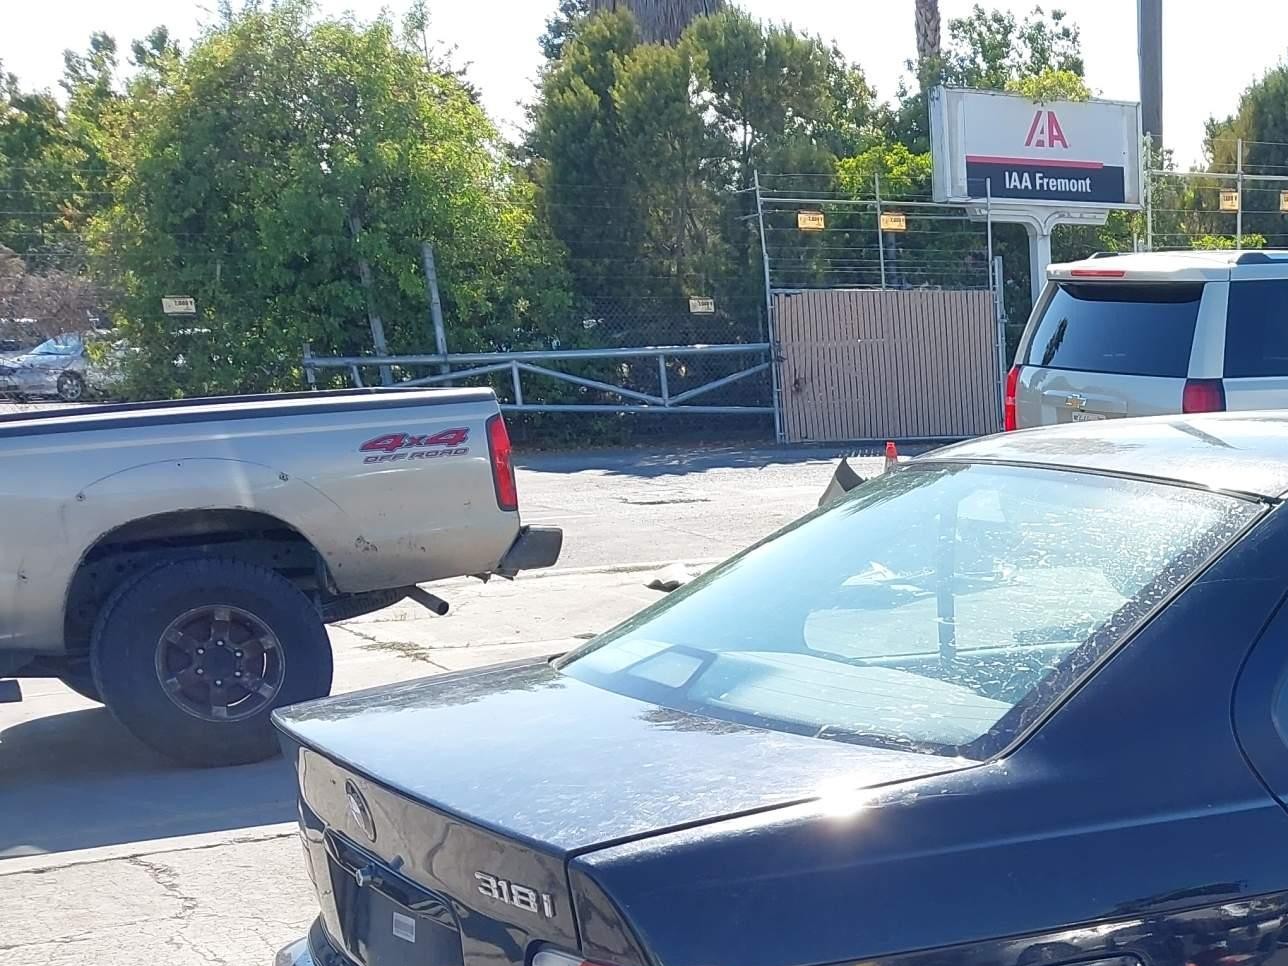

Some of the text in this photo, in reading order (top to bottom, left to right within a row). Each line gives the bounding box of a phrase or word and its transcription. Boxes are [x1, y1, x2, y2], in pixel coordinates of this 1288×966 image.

[1005, 171, 1091, 192] IAA Fremont
[407, 447, 469, 460] ROAD
[474, 871, 554, 918] 318i
